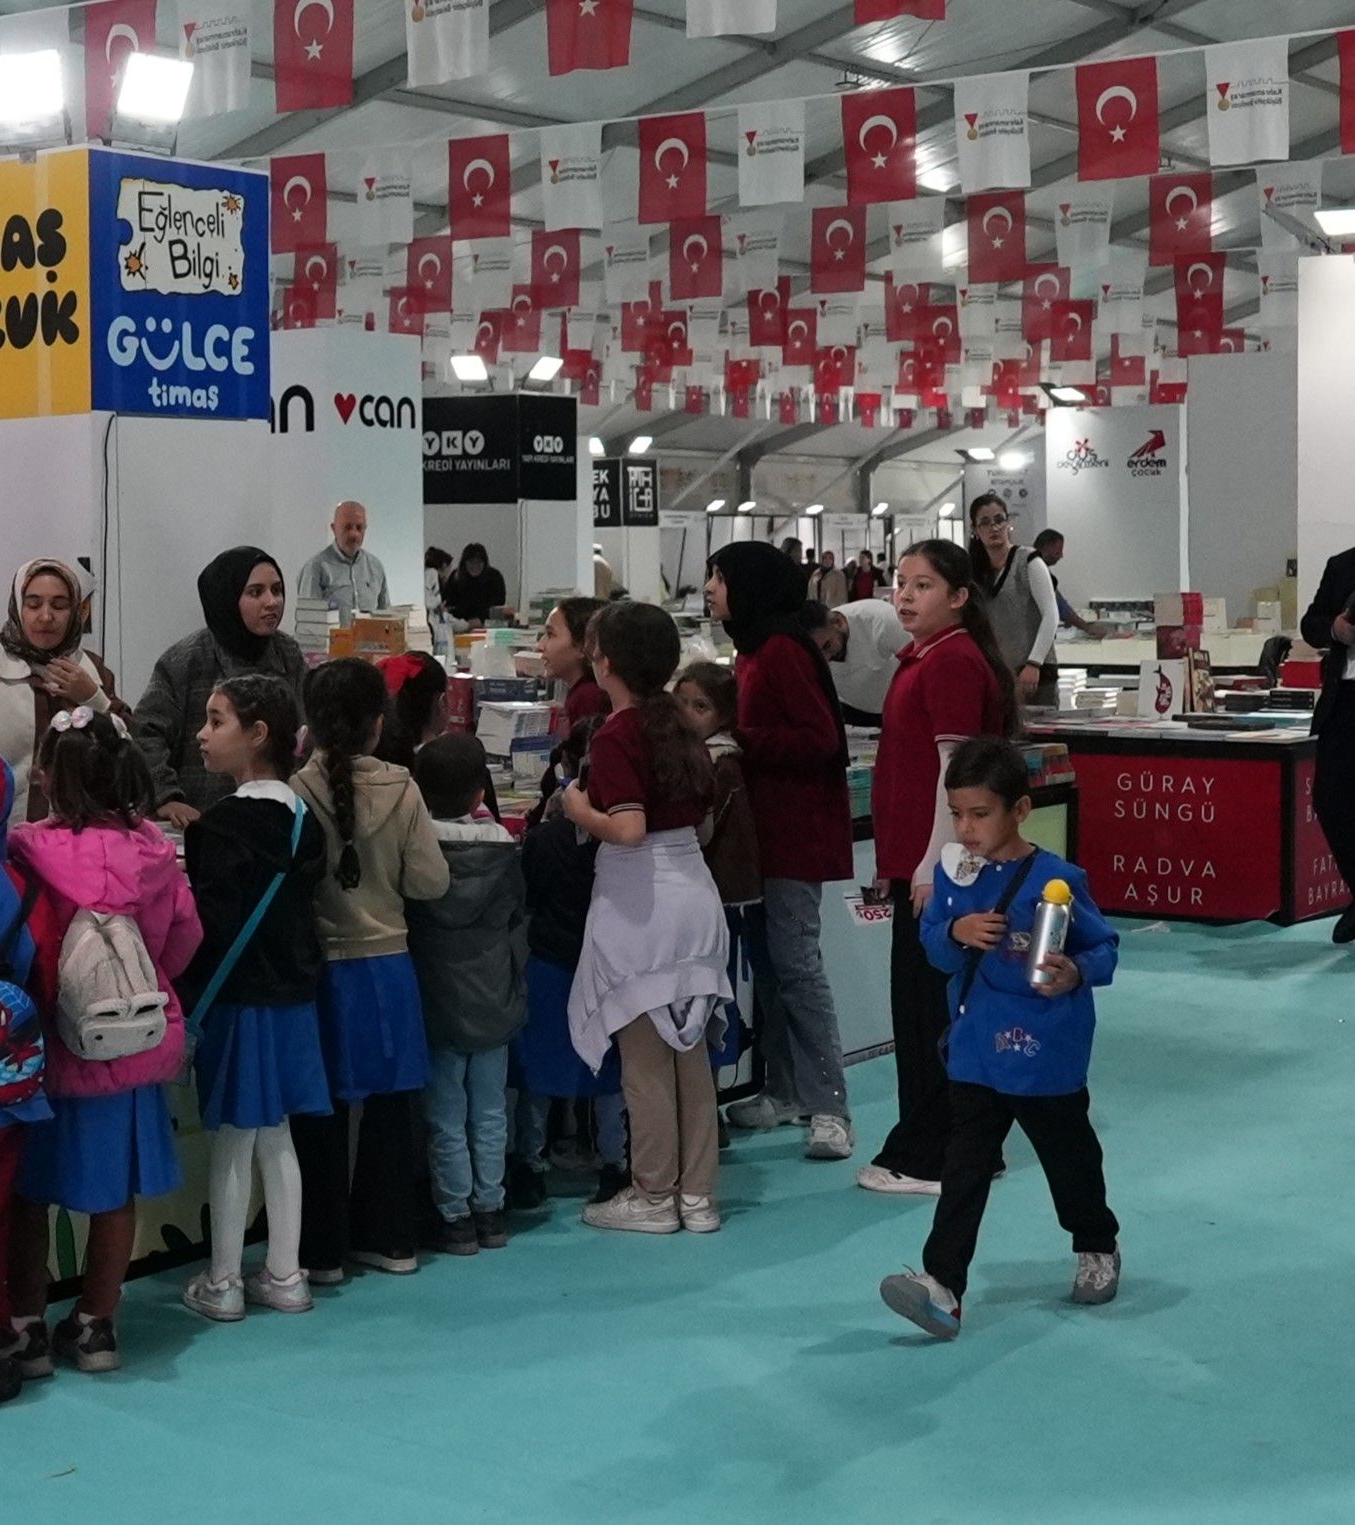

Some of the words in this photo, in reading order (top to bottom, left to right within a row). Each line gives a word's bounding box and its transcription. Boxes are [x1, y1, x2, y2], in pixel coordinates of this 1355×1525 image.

[137, 191, 225, 243] Eğlenceli
[169, 239, 219, 289] Bilgi
[107, 315, 255, 375] GÜLCE
[147, 376, 219, 411] timaş
[359, 394, 416, 429] can
[424, 432, 483, 454] YKY
[454, 458, 511, 471] YAYINLARI
[1127, 457, 1167, 469] erdem
[1131, 467, 1162, 477] çocuk
[1116, 770, 1215, 795] GÜRAY
[1114, 798, 1215, 823] SÜNGÜ
[1113, 854, 1216, 879] RADVA
[1124, 883, 1203, 906] AŞUR
[1308, 879, 1351, 906] BAYRA
